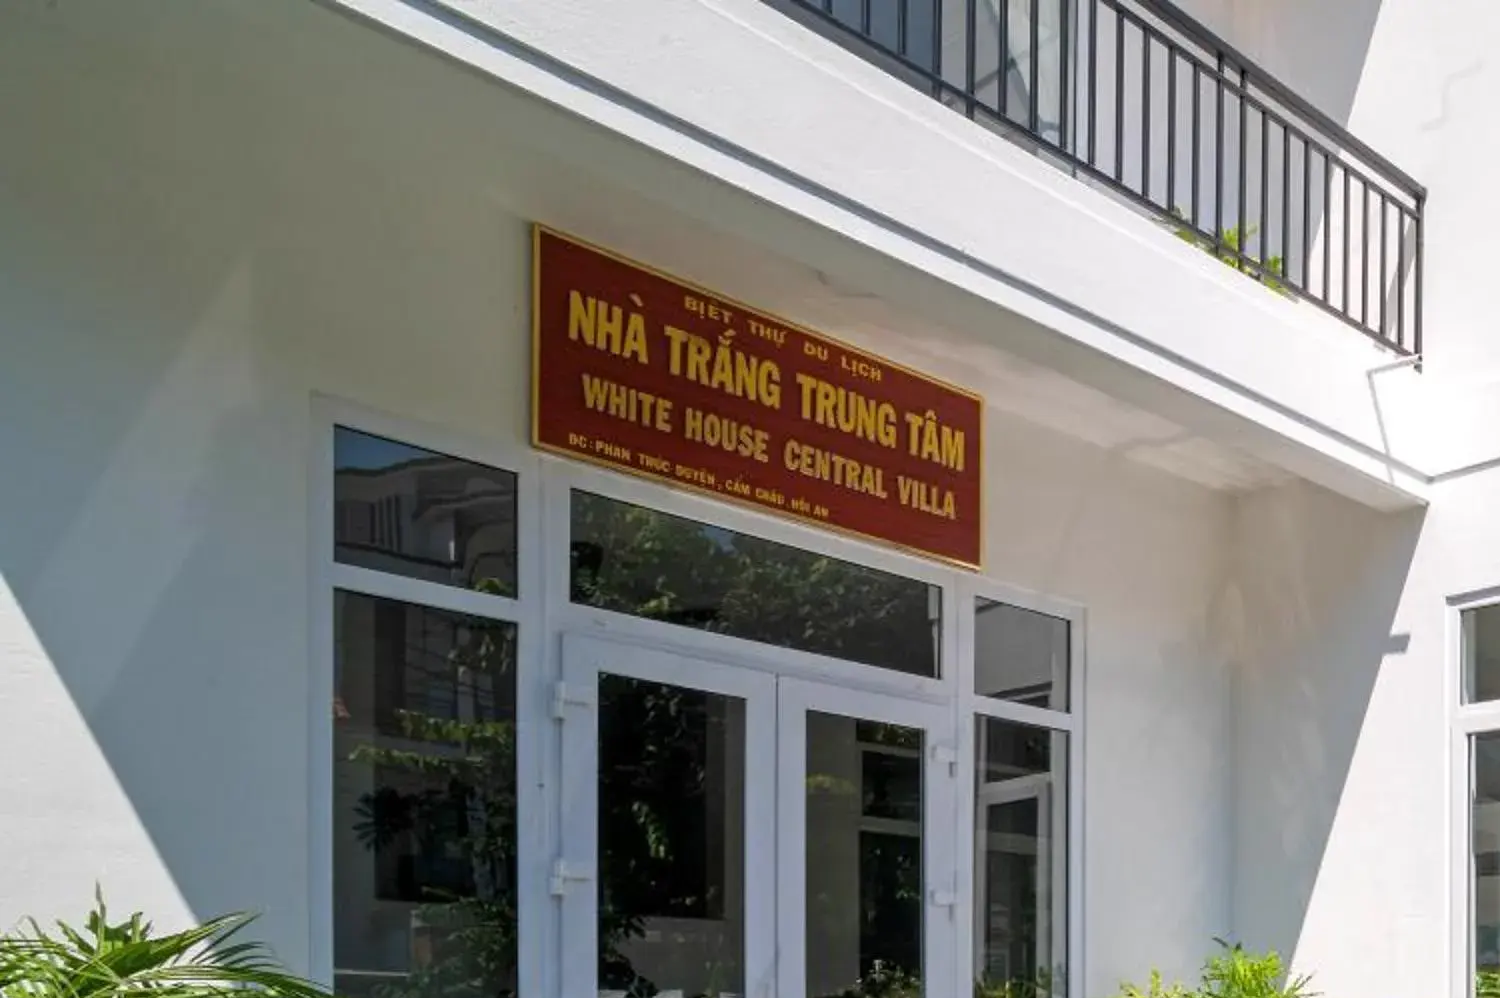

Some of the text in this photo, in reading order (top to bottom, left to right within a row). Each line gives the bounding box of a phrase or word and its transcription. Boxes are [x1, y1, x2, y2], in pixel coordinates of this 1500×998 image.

[568, 290, 965, 472] NHÀ TRẮNG TRUNG TÂM
[803, 340, 829, 361] DU
[841, 355, 881, 382] LỊCH
[582, 373, 956, 520] WHITE HOUSE CENTRAL VILLA
